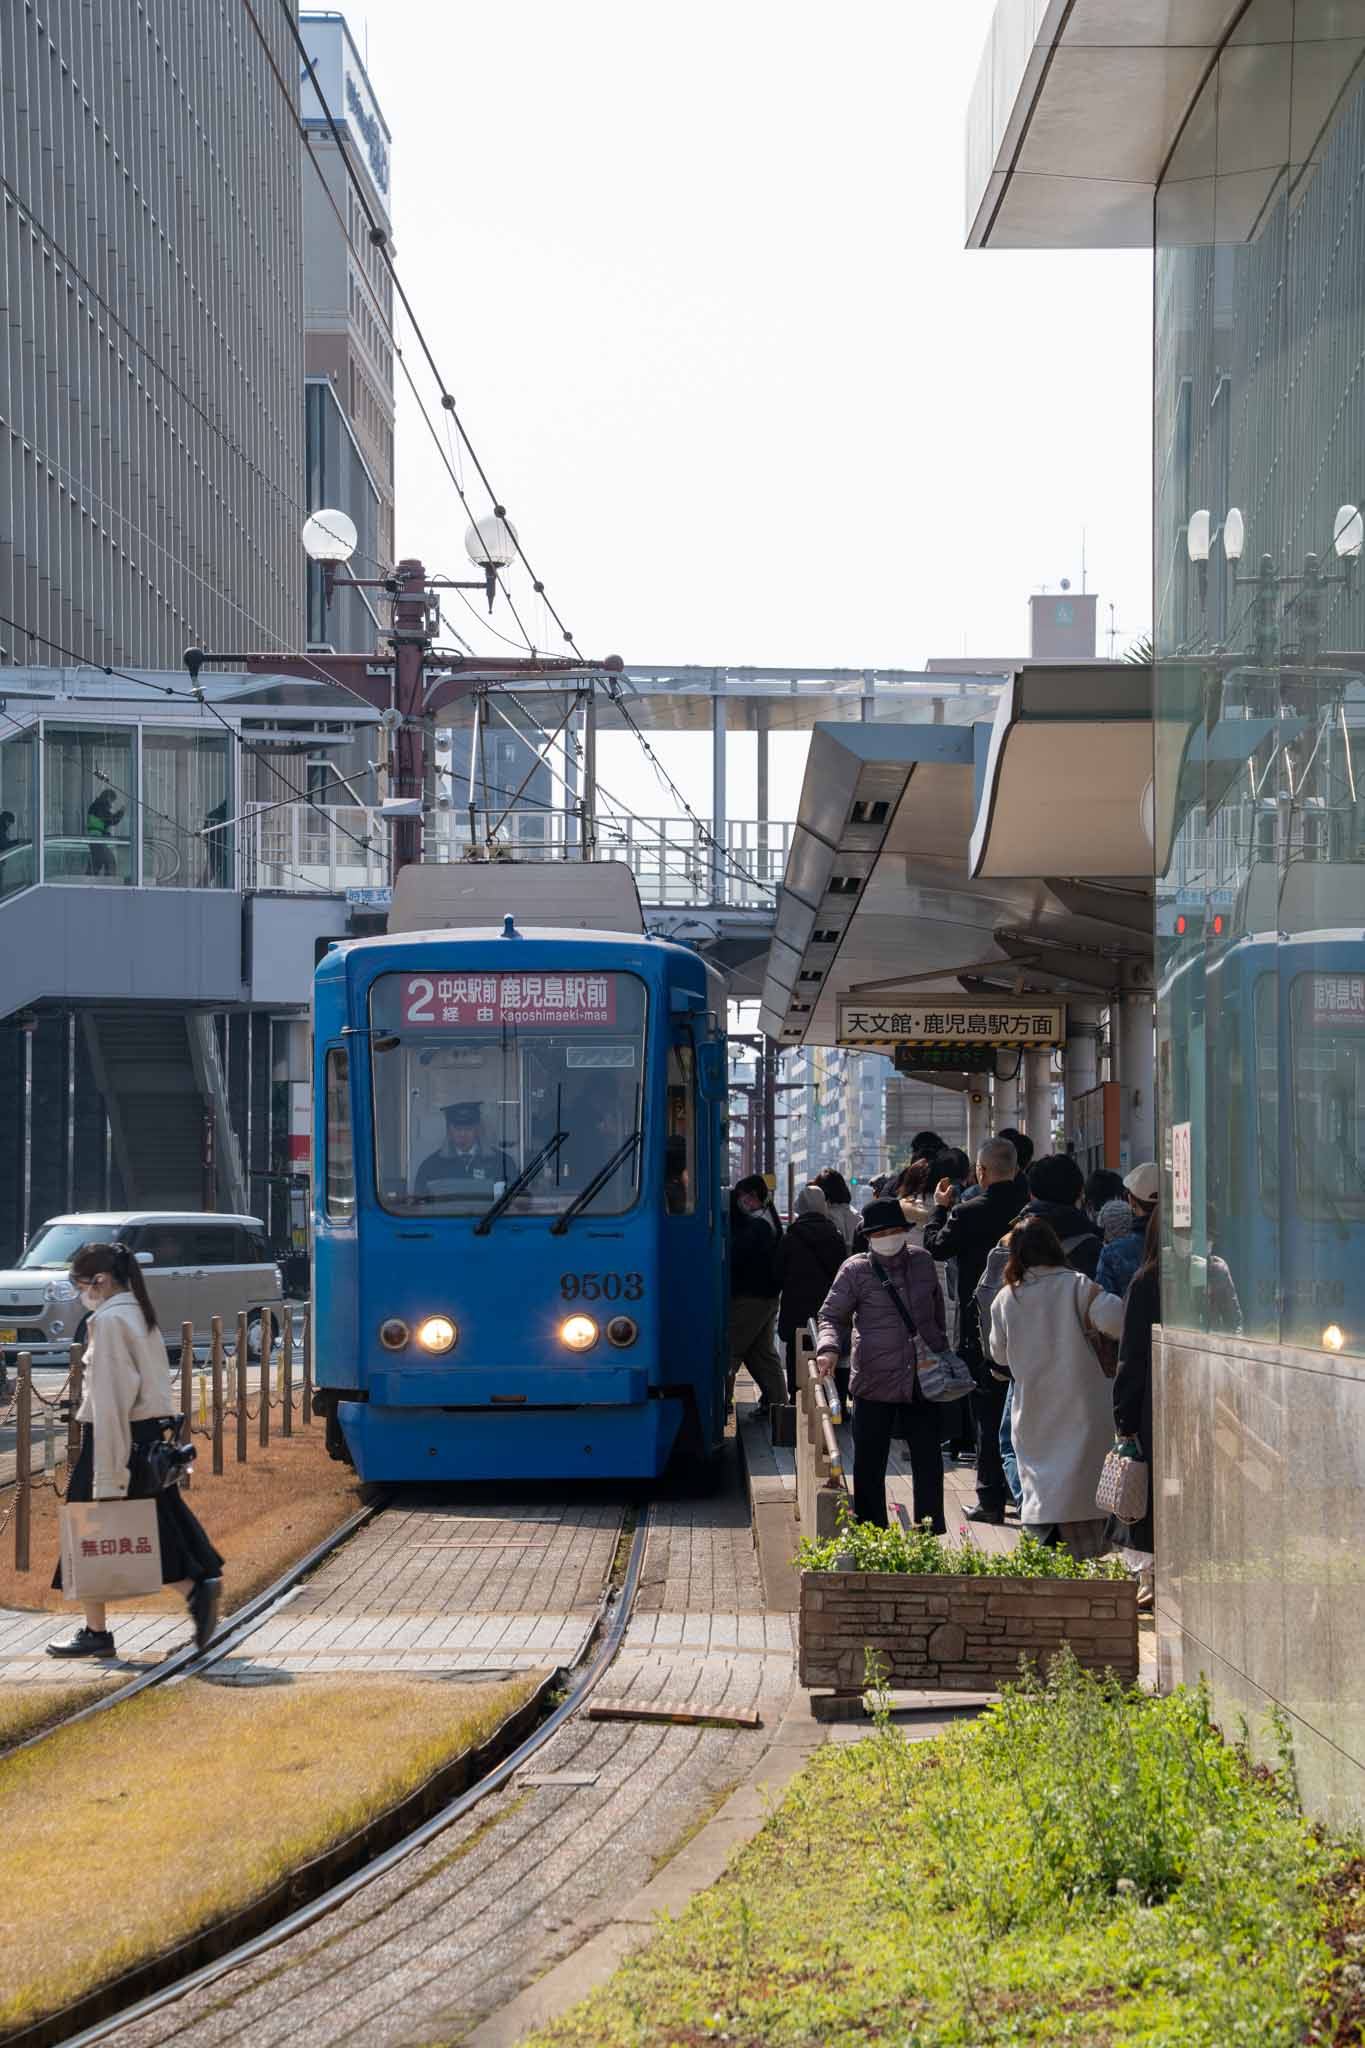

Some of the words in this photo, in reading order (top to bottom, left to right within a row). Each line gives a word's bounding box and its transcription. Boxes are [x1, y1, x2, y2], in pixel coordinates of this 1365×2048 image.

[408, 978, 435, 1022] 2
[438, 978, 497, 1004] 中央駅前
[500, 977, 608, 1009] 鹿児島駅前
[500, 1009, 608, 1023] Kagoshimaeki-mae
[847, 1013, 1053, 1036] 天文館・鹿児島駅方面
[560, 1272, 643, 1301] 9503
[80, 1537, 153, 1557] 無印良品
